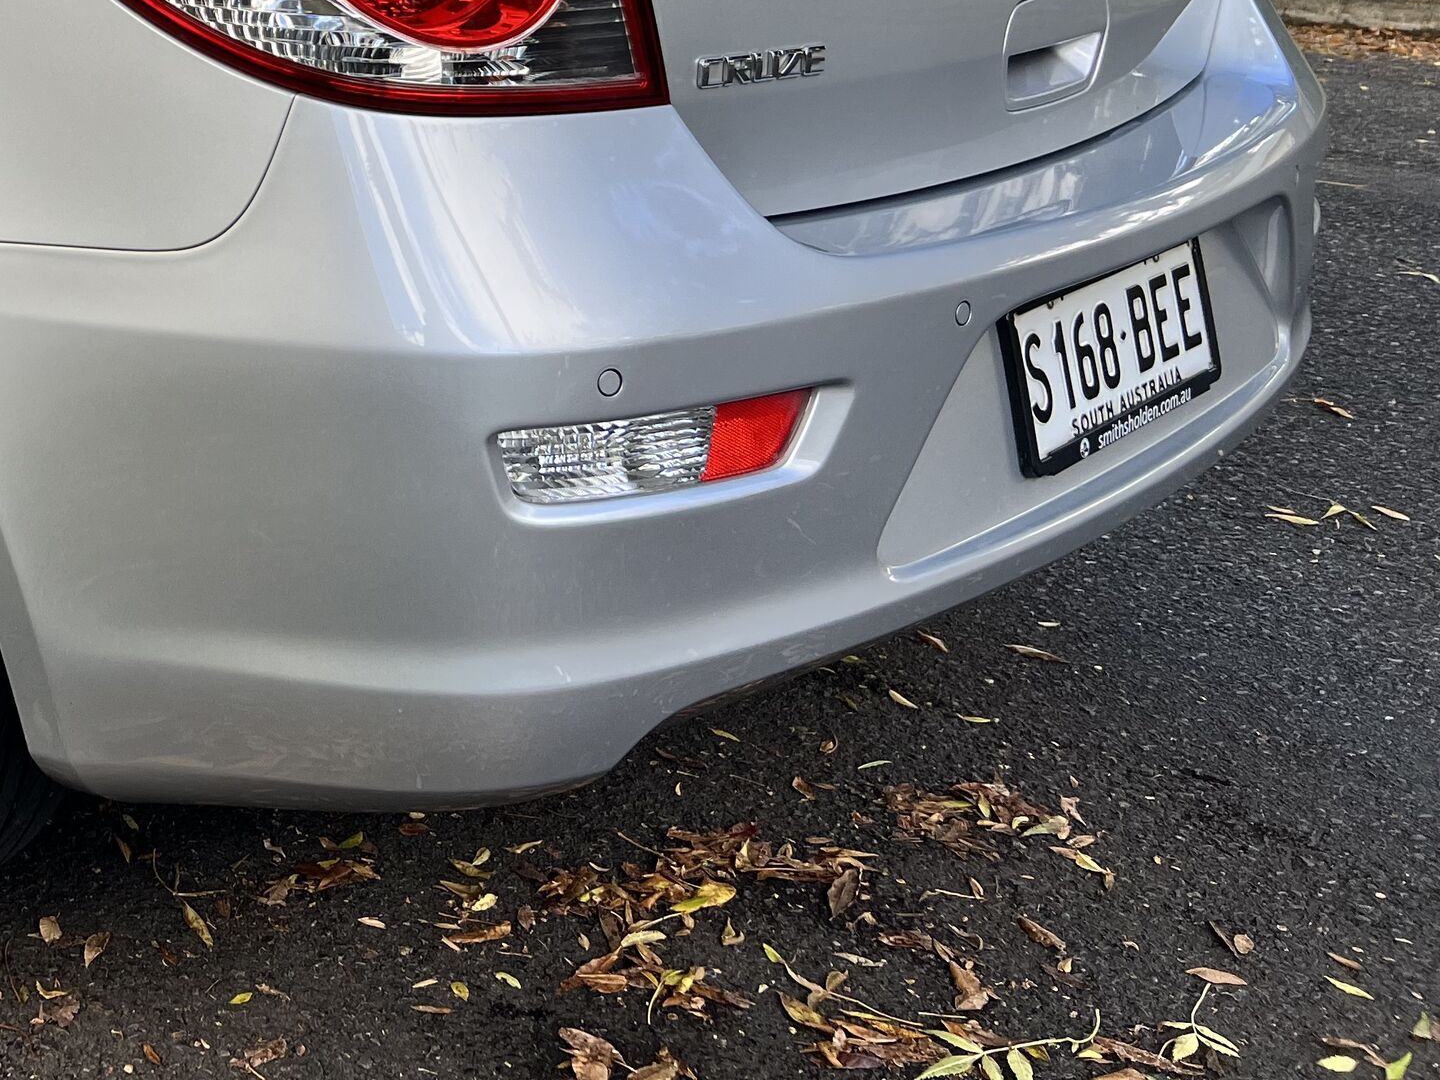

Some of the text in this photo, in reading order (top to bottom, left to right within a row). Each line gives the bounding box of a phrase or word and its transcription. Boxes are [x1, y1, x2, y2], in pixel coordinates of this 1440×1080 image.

[696, 45, 826, 89] CRUZE
[1071, 366, 1183, 437] SOUTH AUSTRALIA
[1098, 386, 1192, 449] smithsholden.com.au
